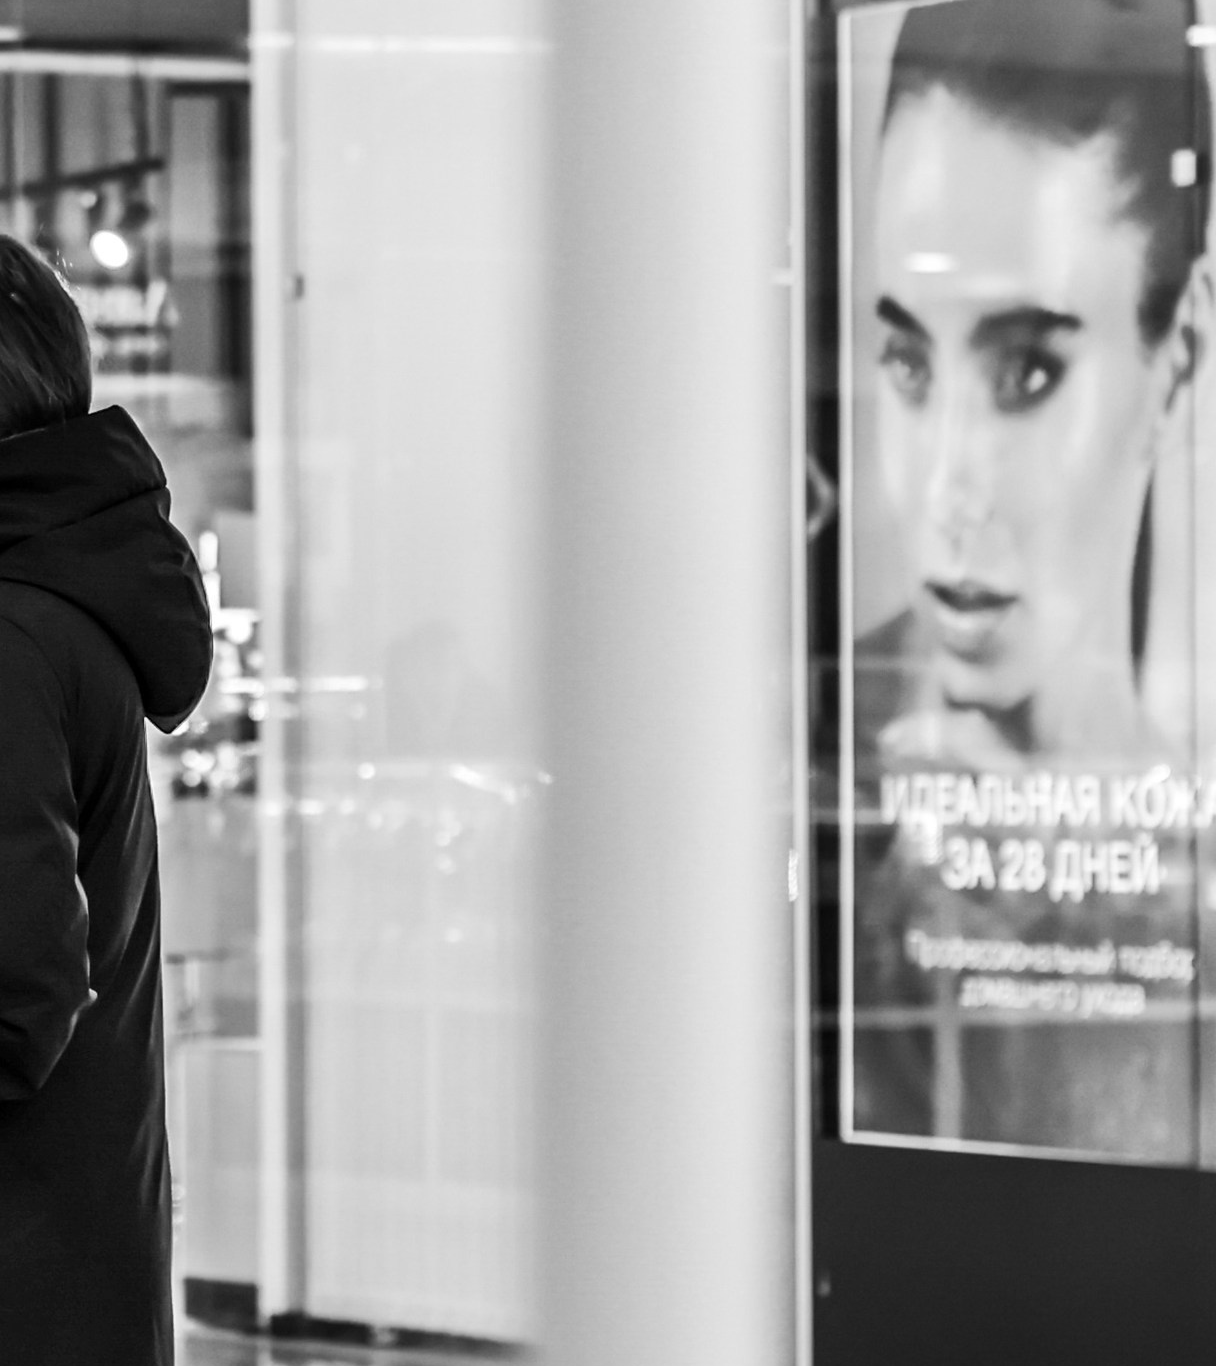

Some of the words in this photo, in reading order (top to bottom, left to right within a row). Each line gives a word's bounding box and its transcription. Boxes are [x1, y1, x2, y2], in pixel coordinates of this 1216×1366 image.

[881, 771, 1102, 827] ИДЕАЛЬНАЯ
[940, 835, 996, 891] ЗА
[998, 838, 1047, 893] 28
[1048, 830, 1160, 903] ДНЕЙ
